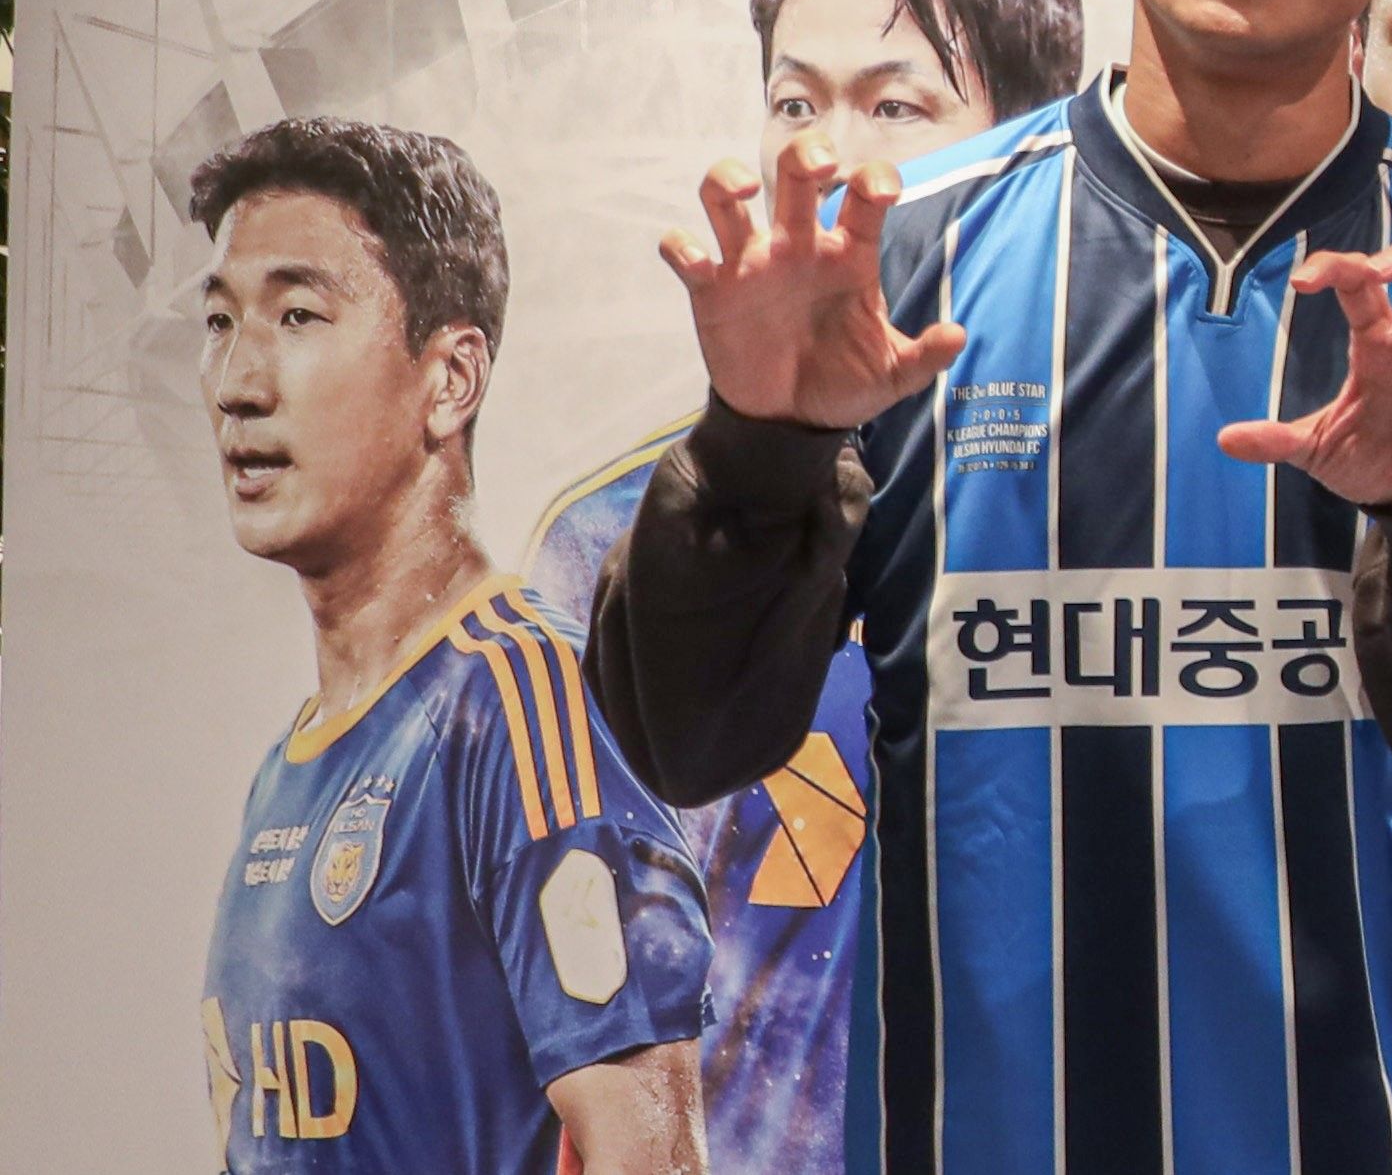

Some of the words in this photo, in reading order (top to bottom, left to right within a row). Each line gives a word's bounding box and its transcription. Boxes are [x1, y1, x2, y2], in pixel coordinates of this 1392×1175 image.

[952, 386, 971, 400] THE
[988, 381, 1015, 397] BLUE
[1019, 383, 1045, 398] STAR
[988, 422, 1048, 438] CHAMPIONS
[981, 440, 1025, 455] HYUNDAI
[1027, 441, 1041, 454] FC
[952, 598, 1348, 700] 현대중공
[251, 1019, 358, 1139] HD
